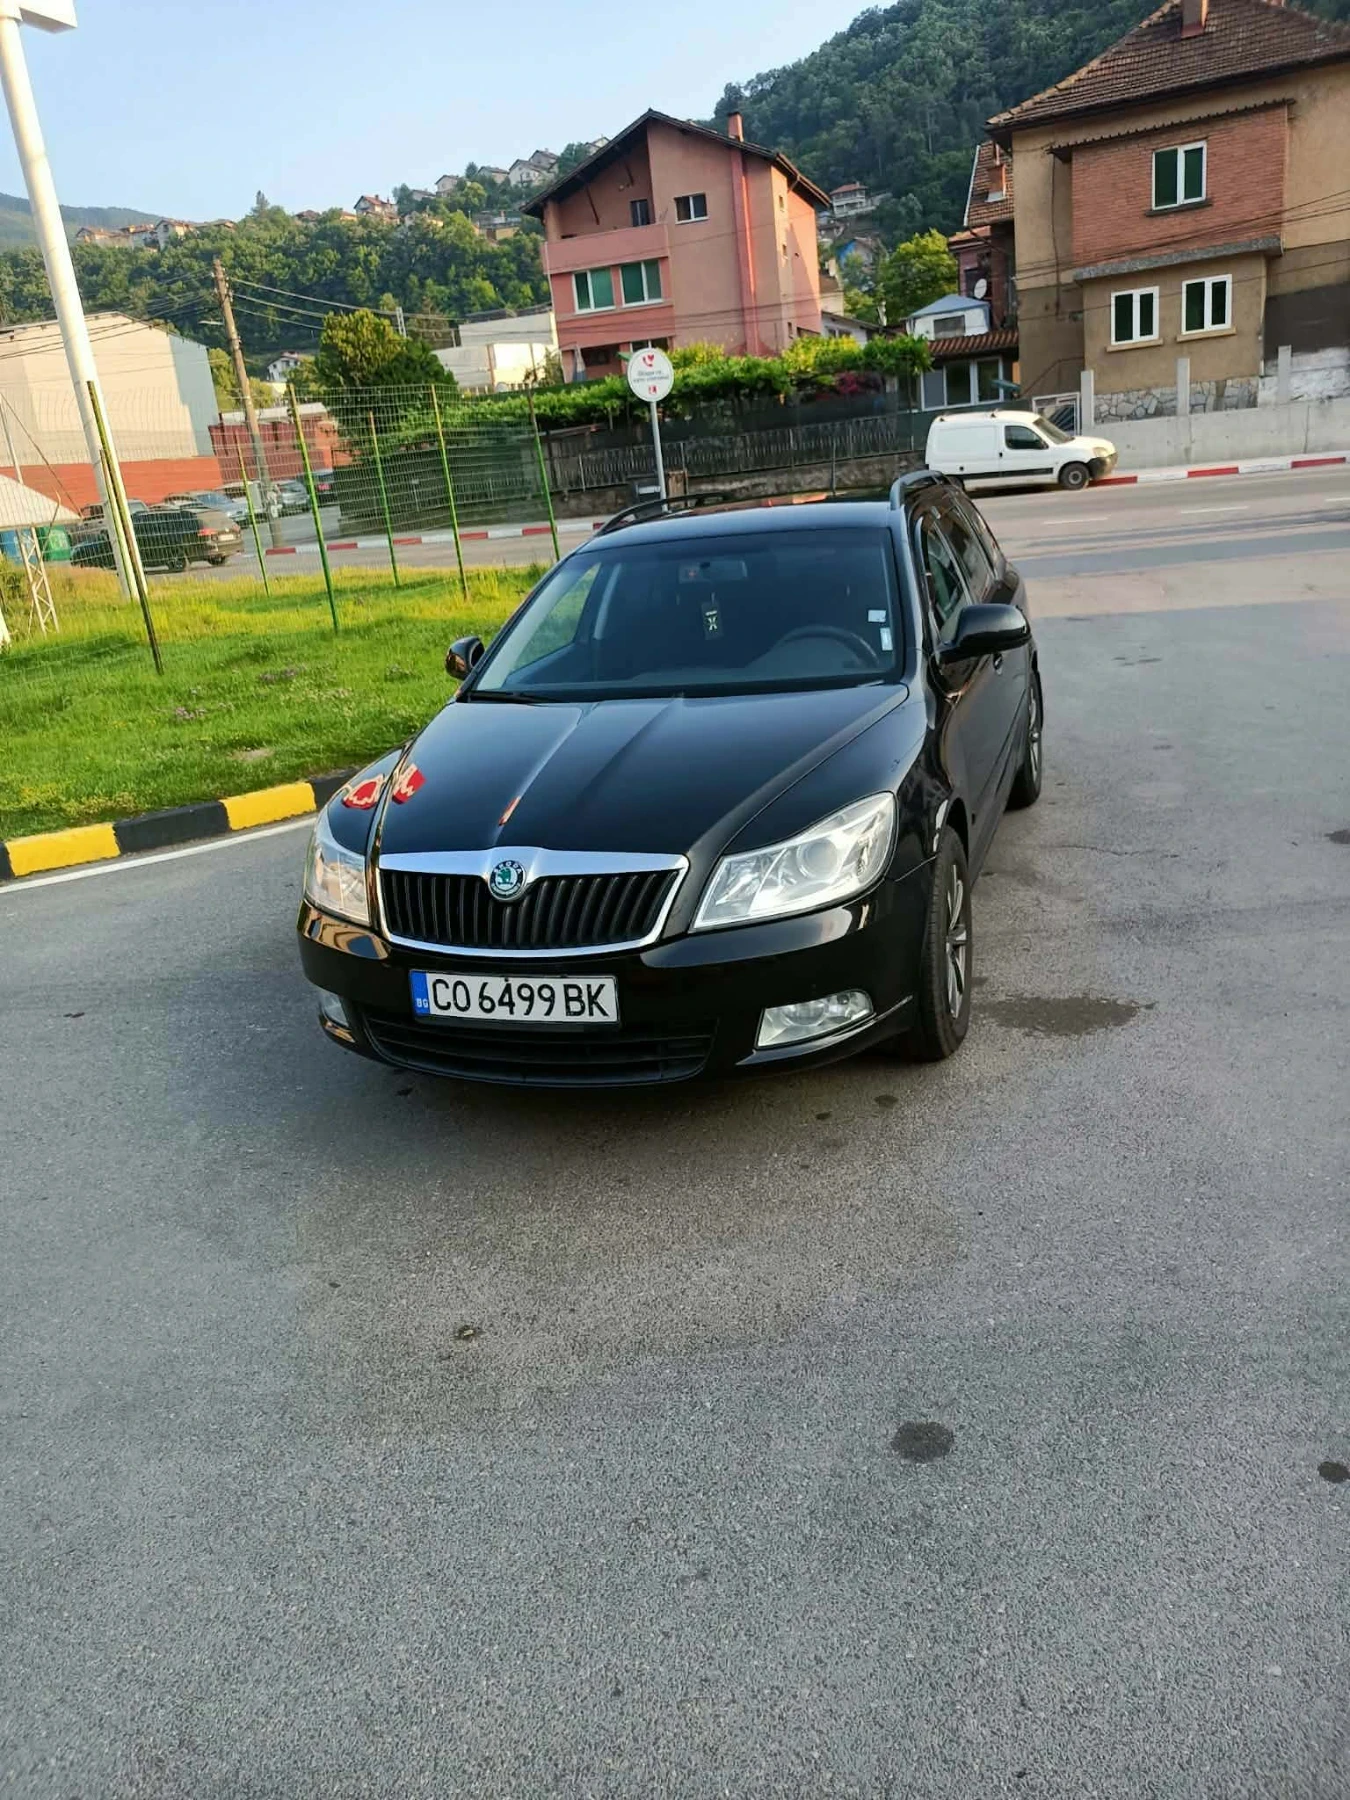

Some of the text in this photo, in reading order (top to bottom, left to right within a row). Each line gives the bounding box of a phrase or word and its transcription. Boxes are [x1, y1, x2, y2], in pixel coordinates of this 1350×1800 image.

[416, 997, 429, 1009] BG
[432, 978, 610, 1017] CO 6499 BK
